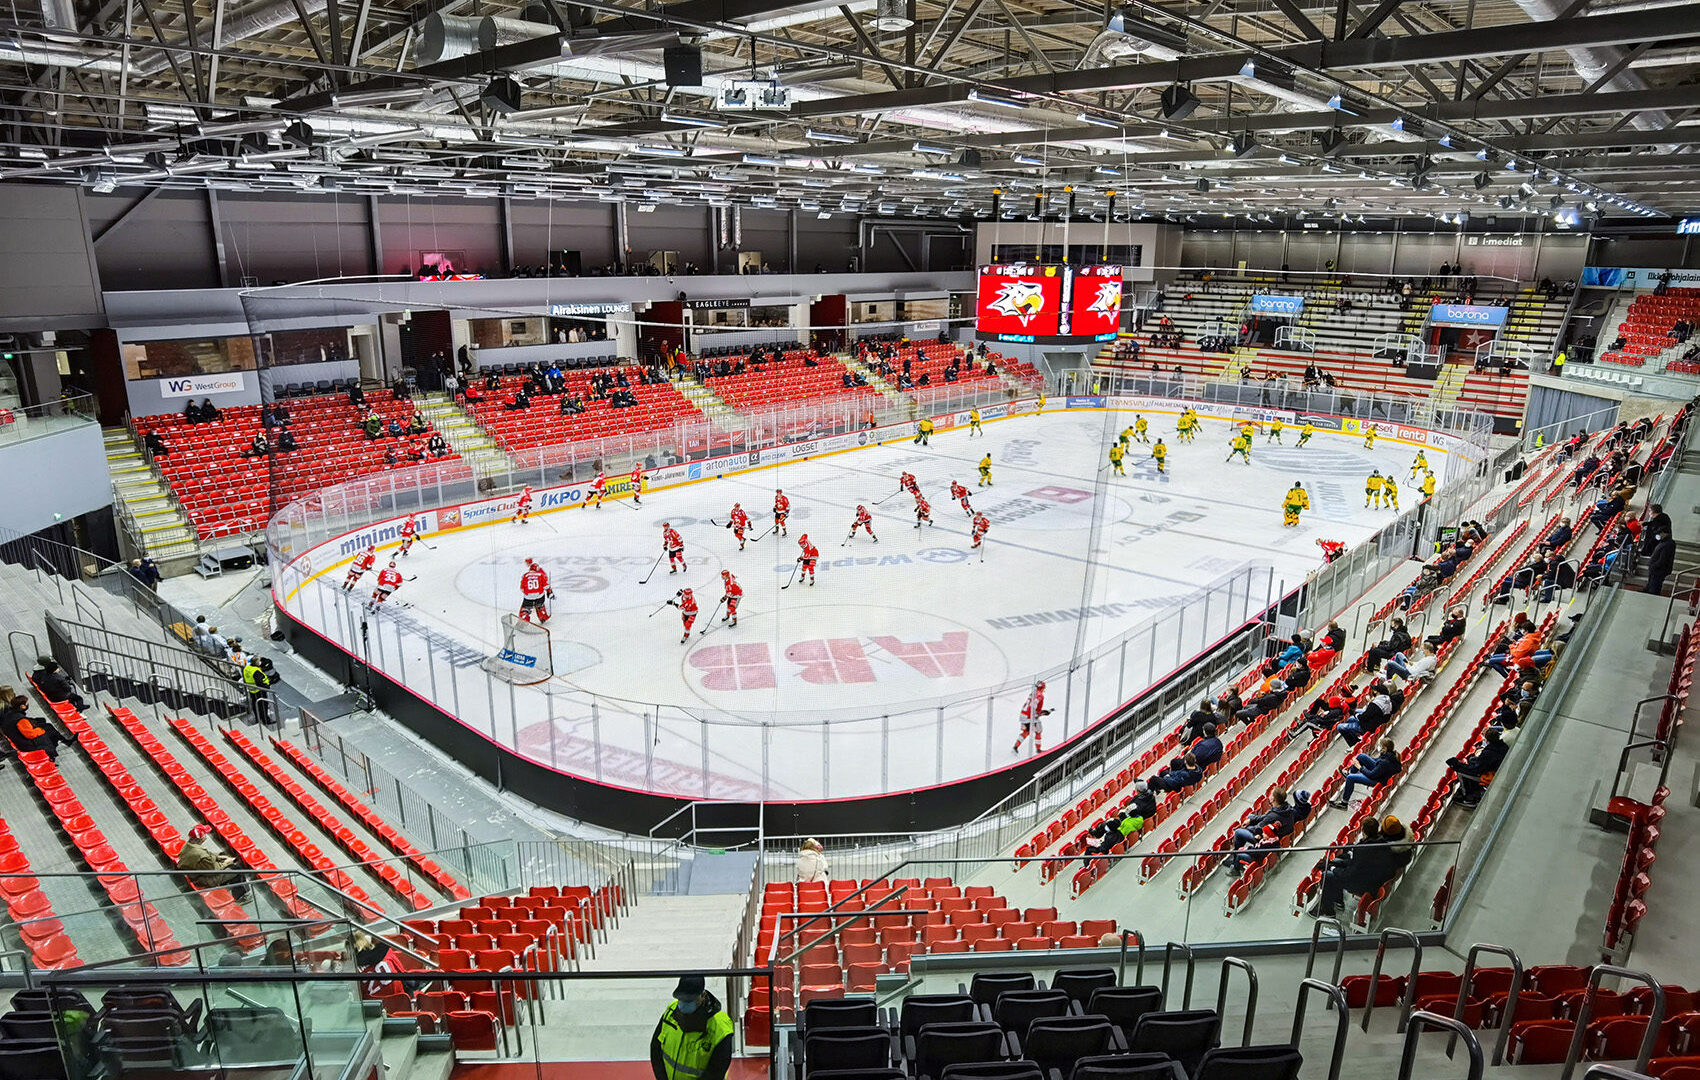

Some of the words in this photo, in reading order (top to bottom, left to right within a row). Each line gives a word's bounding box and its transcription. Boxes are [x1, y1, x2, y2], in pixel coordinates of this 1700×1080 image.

[1482, 237, 1523, 246] i-mediat
[552, 304, 600, 315] Airaksinen
[601, 304, 630, 313] LOUNGE
[1260, 299, 1295, 309] barona
[1447, 304, 1490, 320] barona
[168, 380, 192, 392] WG
[195, 381, 236, 391] WestGroup
[1399, 429, 1426, 441] renta
[791, 442, 819, 454] LOGSET
[706, 455, 748, 471] artonauto
[605, 482, 633, 495] MIRE
[549, 489, 582, 506] KPO
[340, 517, 428, 556] minimni
[527, 580, 539, 590] 60
